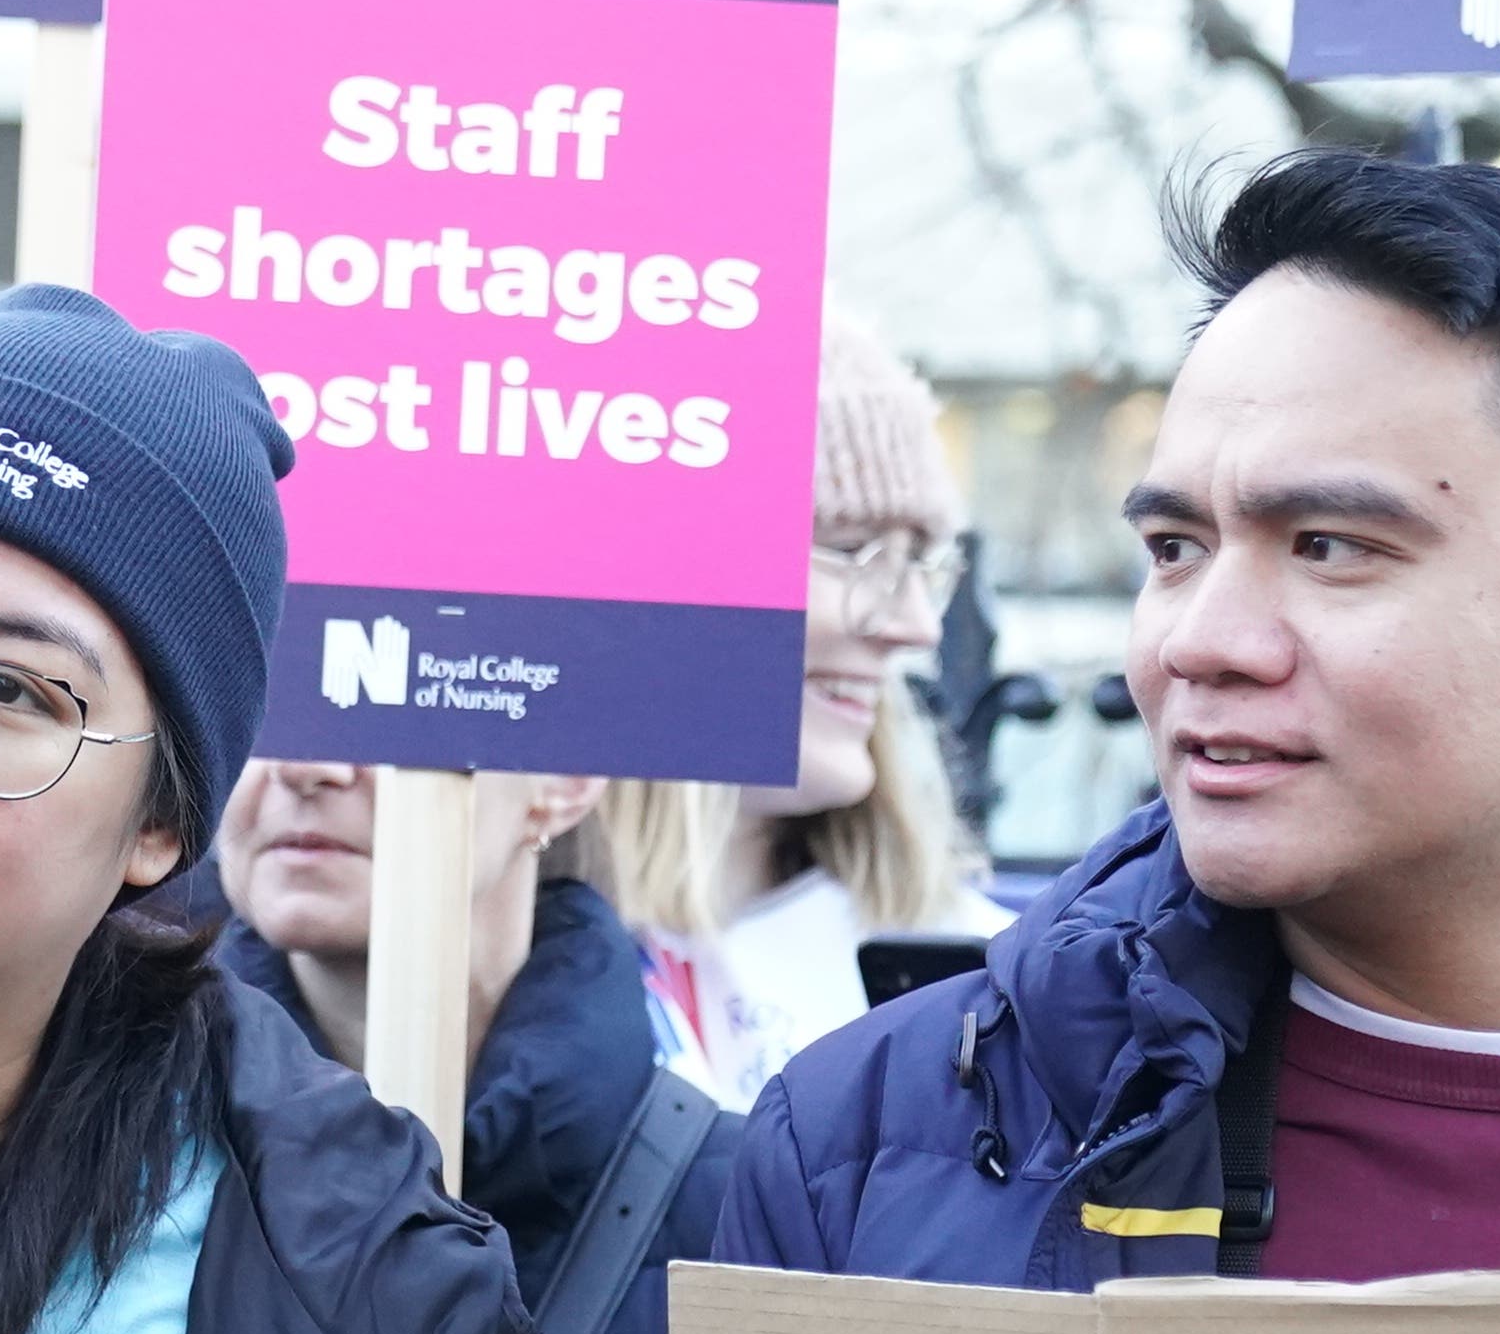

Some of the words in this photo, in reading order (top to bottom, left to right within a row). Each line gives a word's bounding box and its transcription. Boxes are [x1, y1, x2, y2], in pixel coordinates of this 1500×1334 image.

[322, 74, 623, 181] Staff
[163, 207, 763, 345] shortages
[258, 366, 431, 453] ost
[460, 357, 731, 469] lives
[414, 682, 442, 710] of
[443, 683, 527, 720] Nursing
[418, 650, 478, 689] Royal
[480, 654, 560, 693] College
